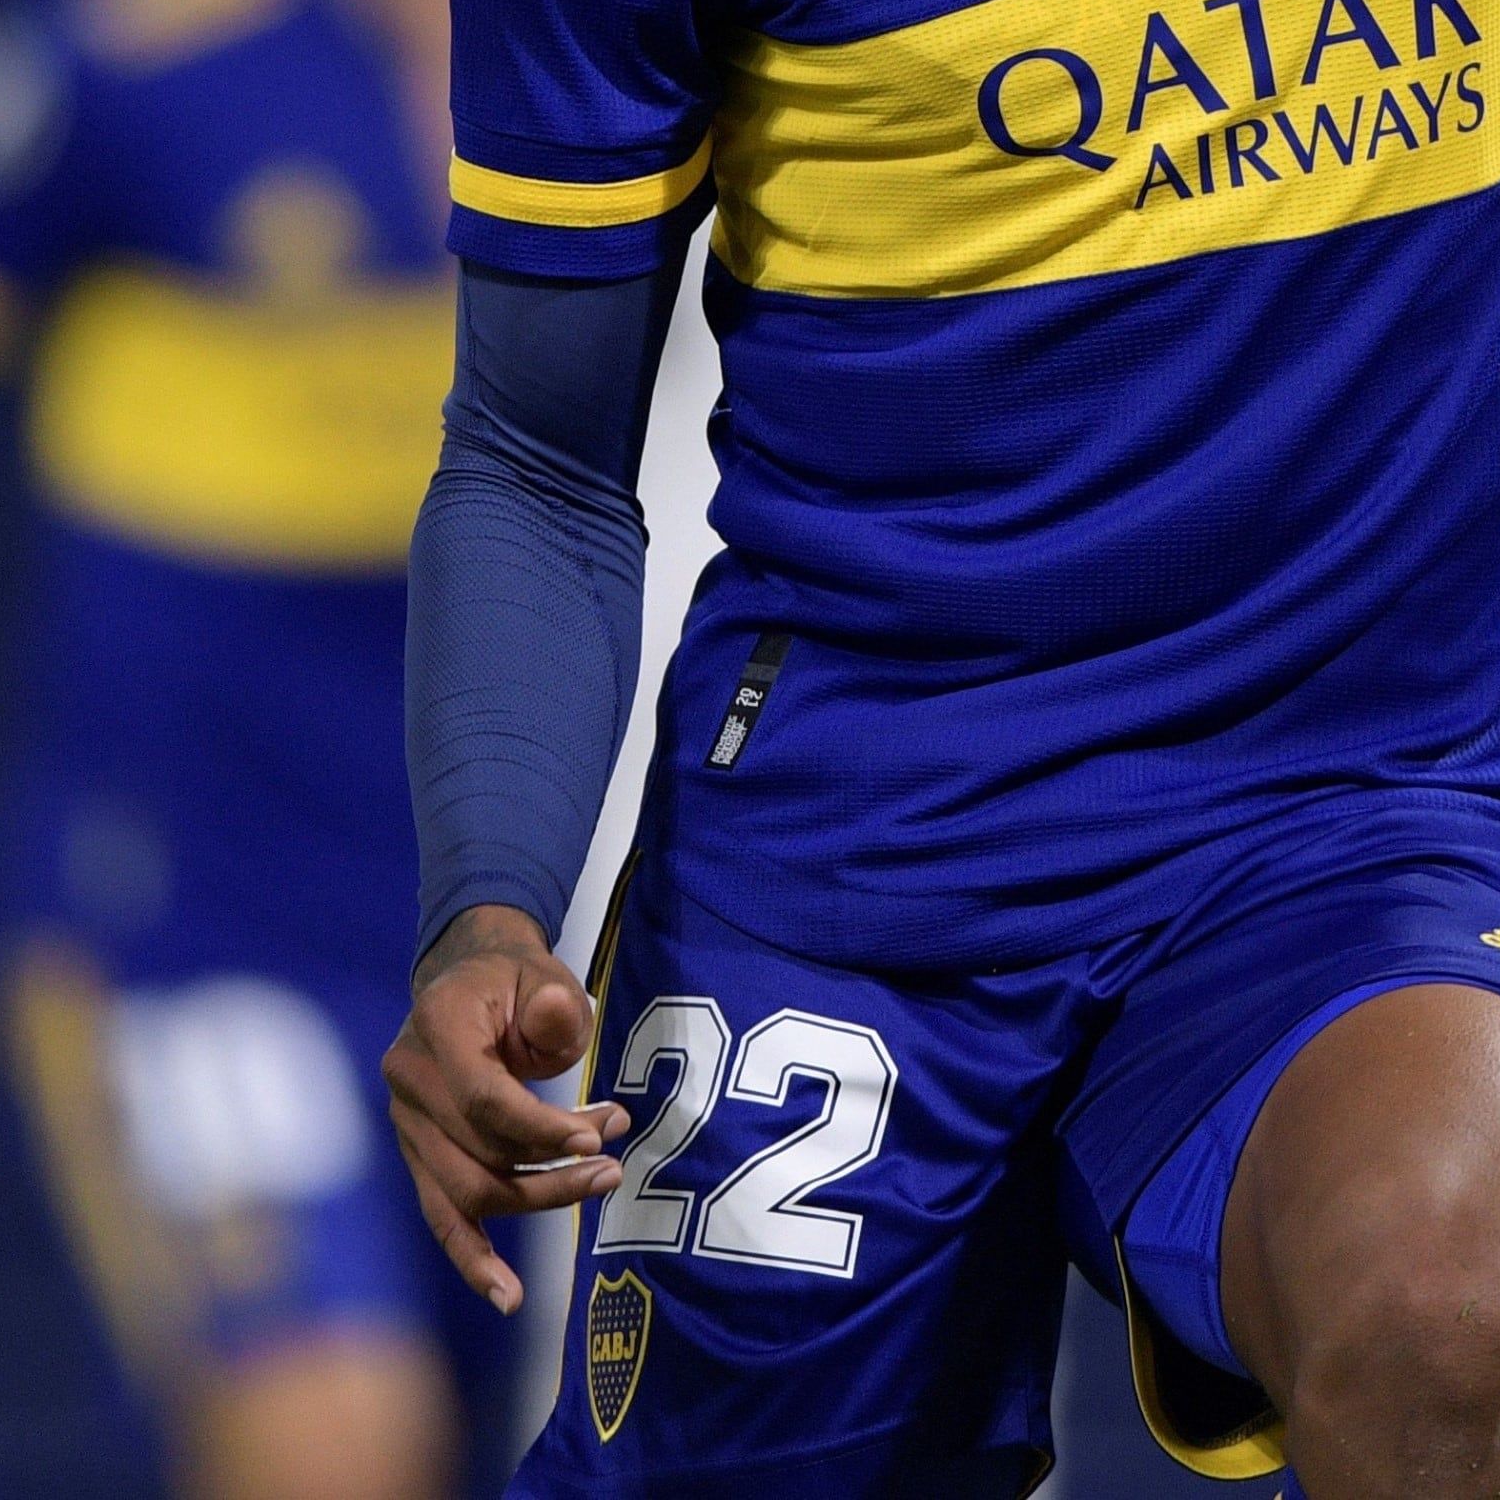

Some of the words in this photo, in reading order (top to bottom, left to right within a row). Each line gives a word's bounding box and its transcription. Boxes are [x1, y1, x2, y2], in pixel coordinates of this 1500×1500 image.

[1133, 62, 1486, 211] AIRWAYS
[592, 996, 899, 1279] 22
[592, 1330, 637, 1363] CABJ
